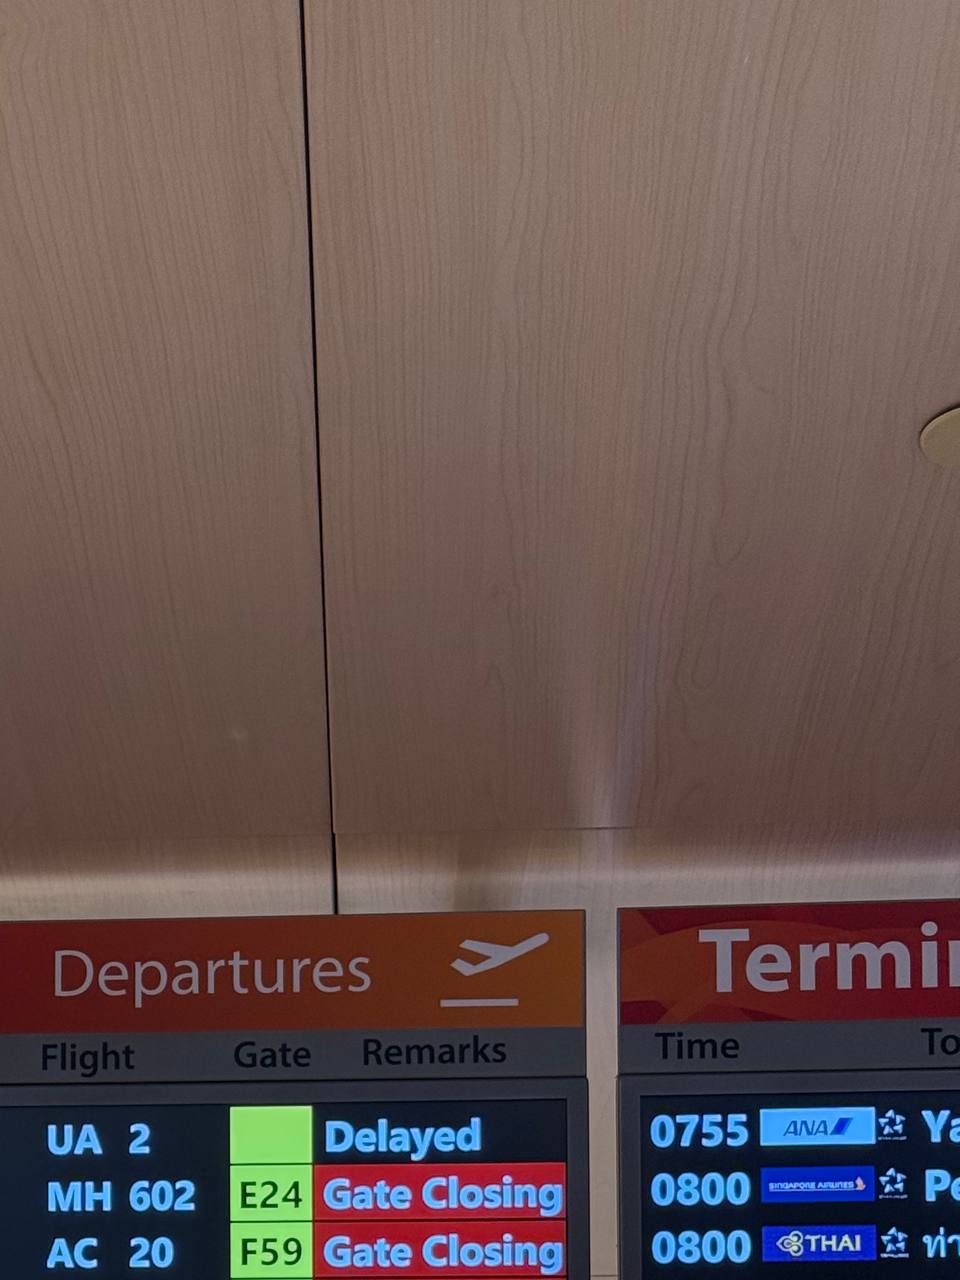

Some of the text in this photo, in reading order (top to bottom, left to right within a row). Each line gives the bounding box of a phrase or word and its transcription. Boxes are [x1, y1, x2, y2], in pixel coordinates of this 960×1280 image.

[55, 950, 371, 1008] Departures
[43, 1042, 134, 1077] Flight
[234, 1042, 310, 1068] Gate
[364, 1035, 506, 1065] Remarks
[655, 1032, 739, 1059] Time
[48, 1123, 150, 1155] UA 2
[326, 1118, 481, 1158] Delayed
[651, 1114, 748, 1147] 0755
[784, 1120, 828, 1136] ANA
[48, 1180, 195, 1211] MH 602
[241, 1181, 302, 1208] E24
[324, 1177, 562, 1214] Gate Closing
[651, 1172, 751, 1206] 0800
[47, 1237, 174, 1268] AC 20
[242, 1238, 301, 1265] F59
[324, 1235, 563, 1274] Gate Closing
[652, 1230, 751, 1264] 0800
[804, 1235, 861, 1251] THAI
